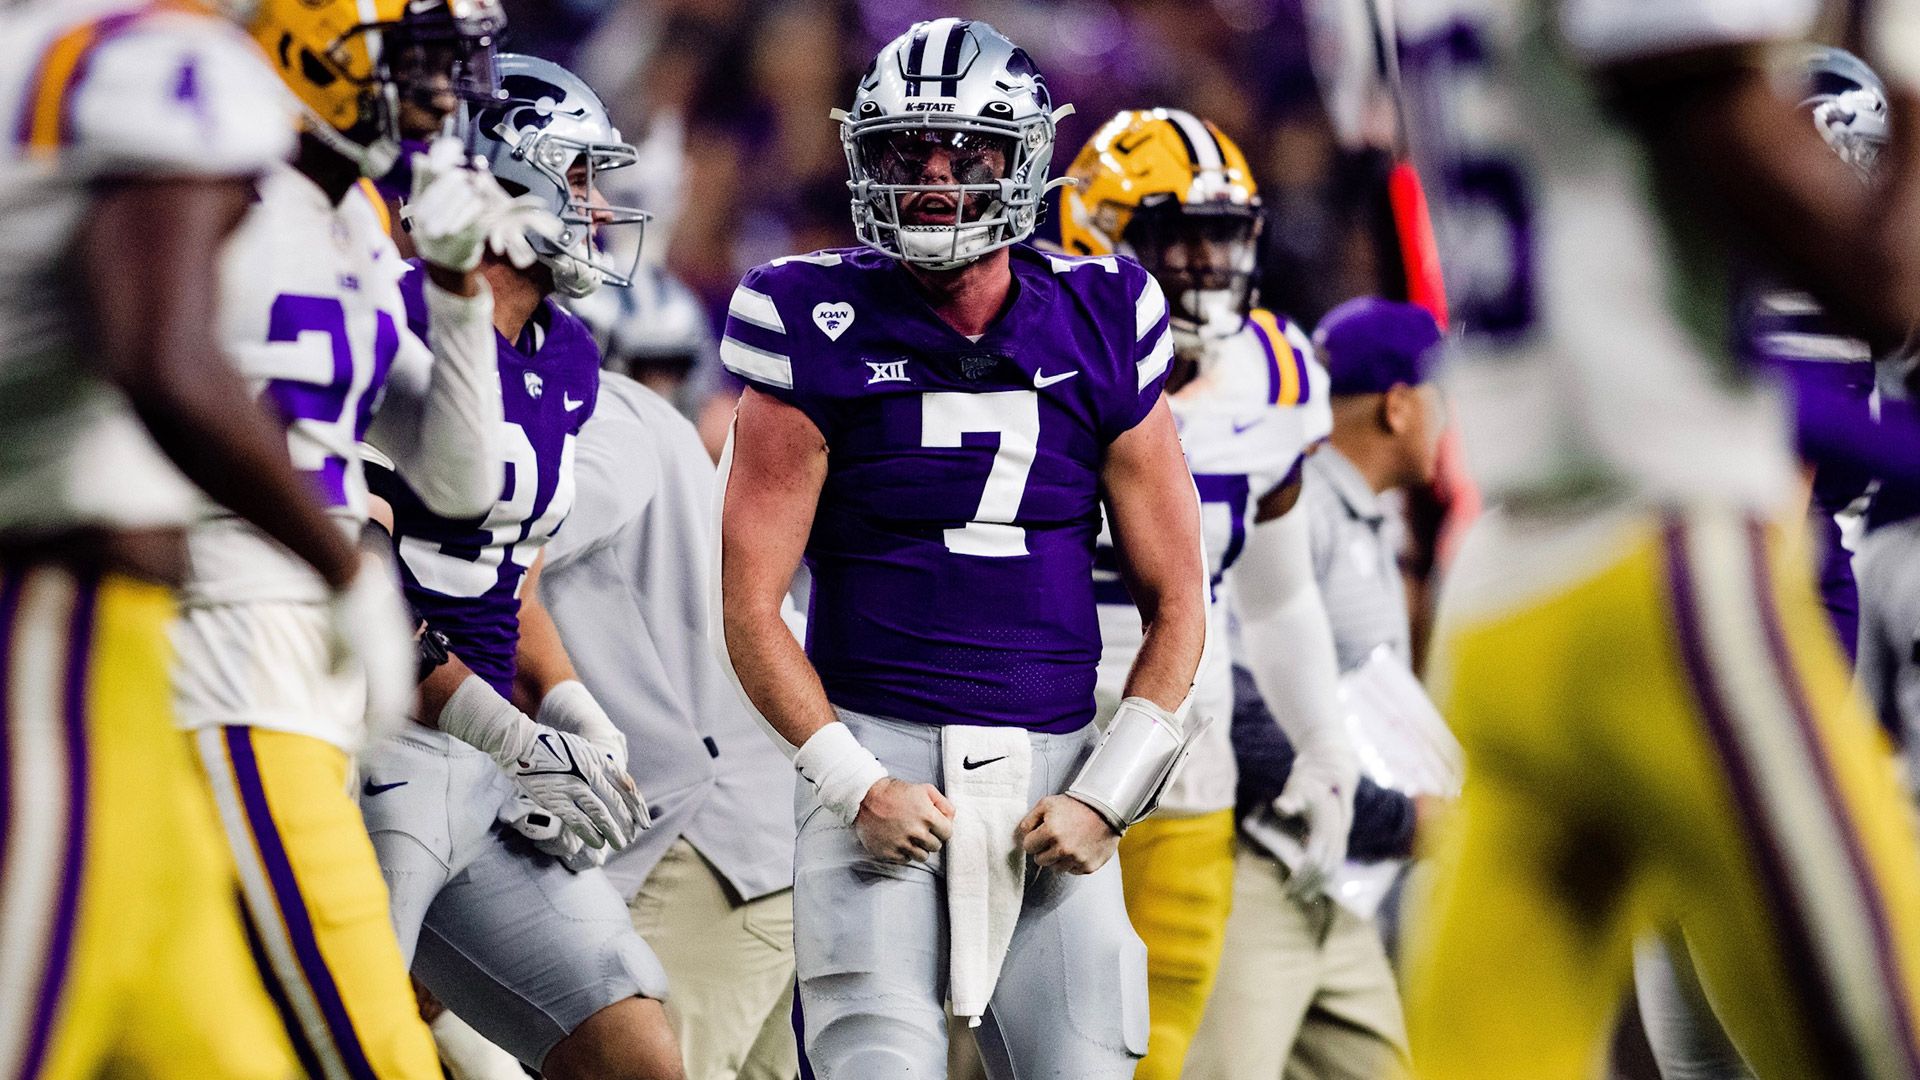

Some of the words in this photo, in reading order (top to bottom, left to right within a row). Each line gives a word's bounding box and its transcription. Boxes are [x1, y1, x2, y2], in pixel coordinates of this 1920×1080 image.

[905, 102, 956, 112] K-STATE
[818, 311, 848, 319] JOAN
[865, 359, 911, 385] XII
[921, 389, 1040, 558] 7
